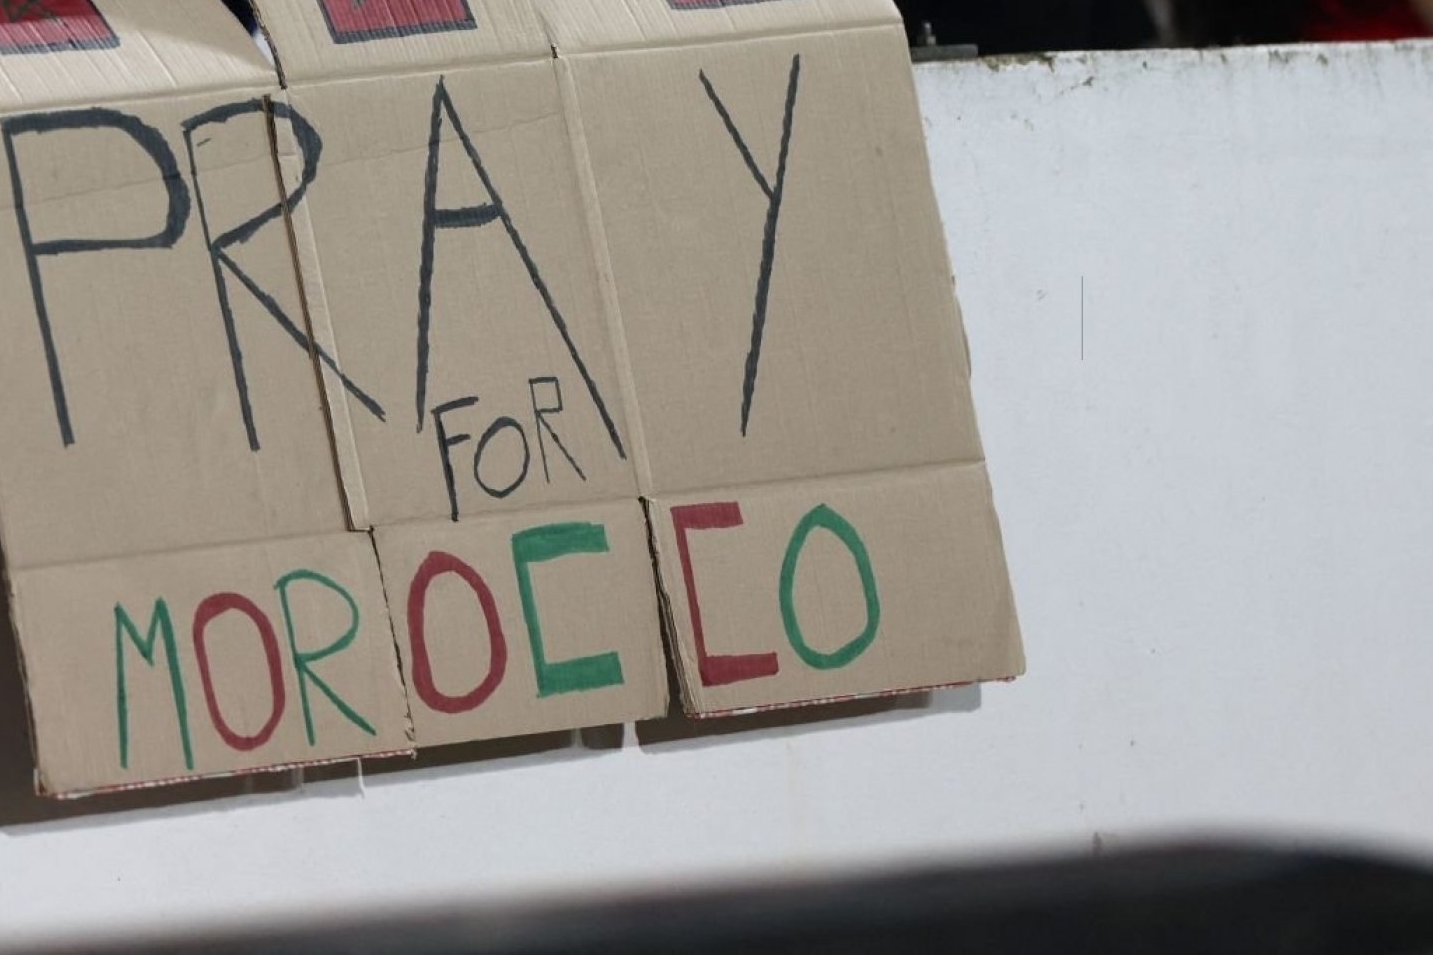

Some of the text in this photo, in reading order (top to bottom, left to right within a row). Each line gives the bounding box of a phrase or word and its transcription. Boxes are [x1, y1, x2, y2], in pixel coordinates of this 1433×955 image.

[0, 54, 800, 459] PRAY
[432, 377, 586, 521] FOR
[115, 503, 882, 770] MOROCCO
